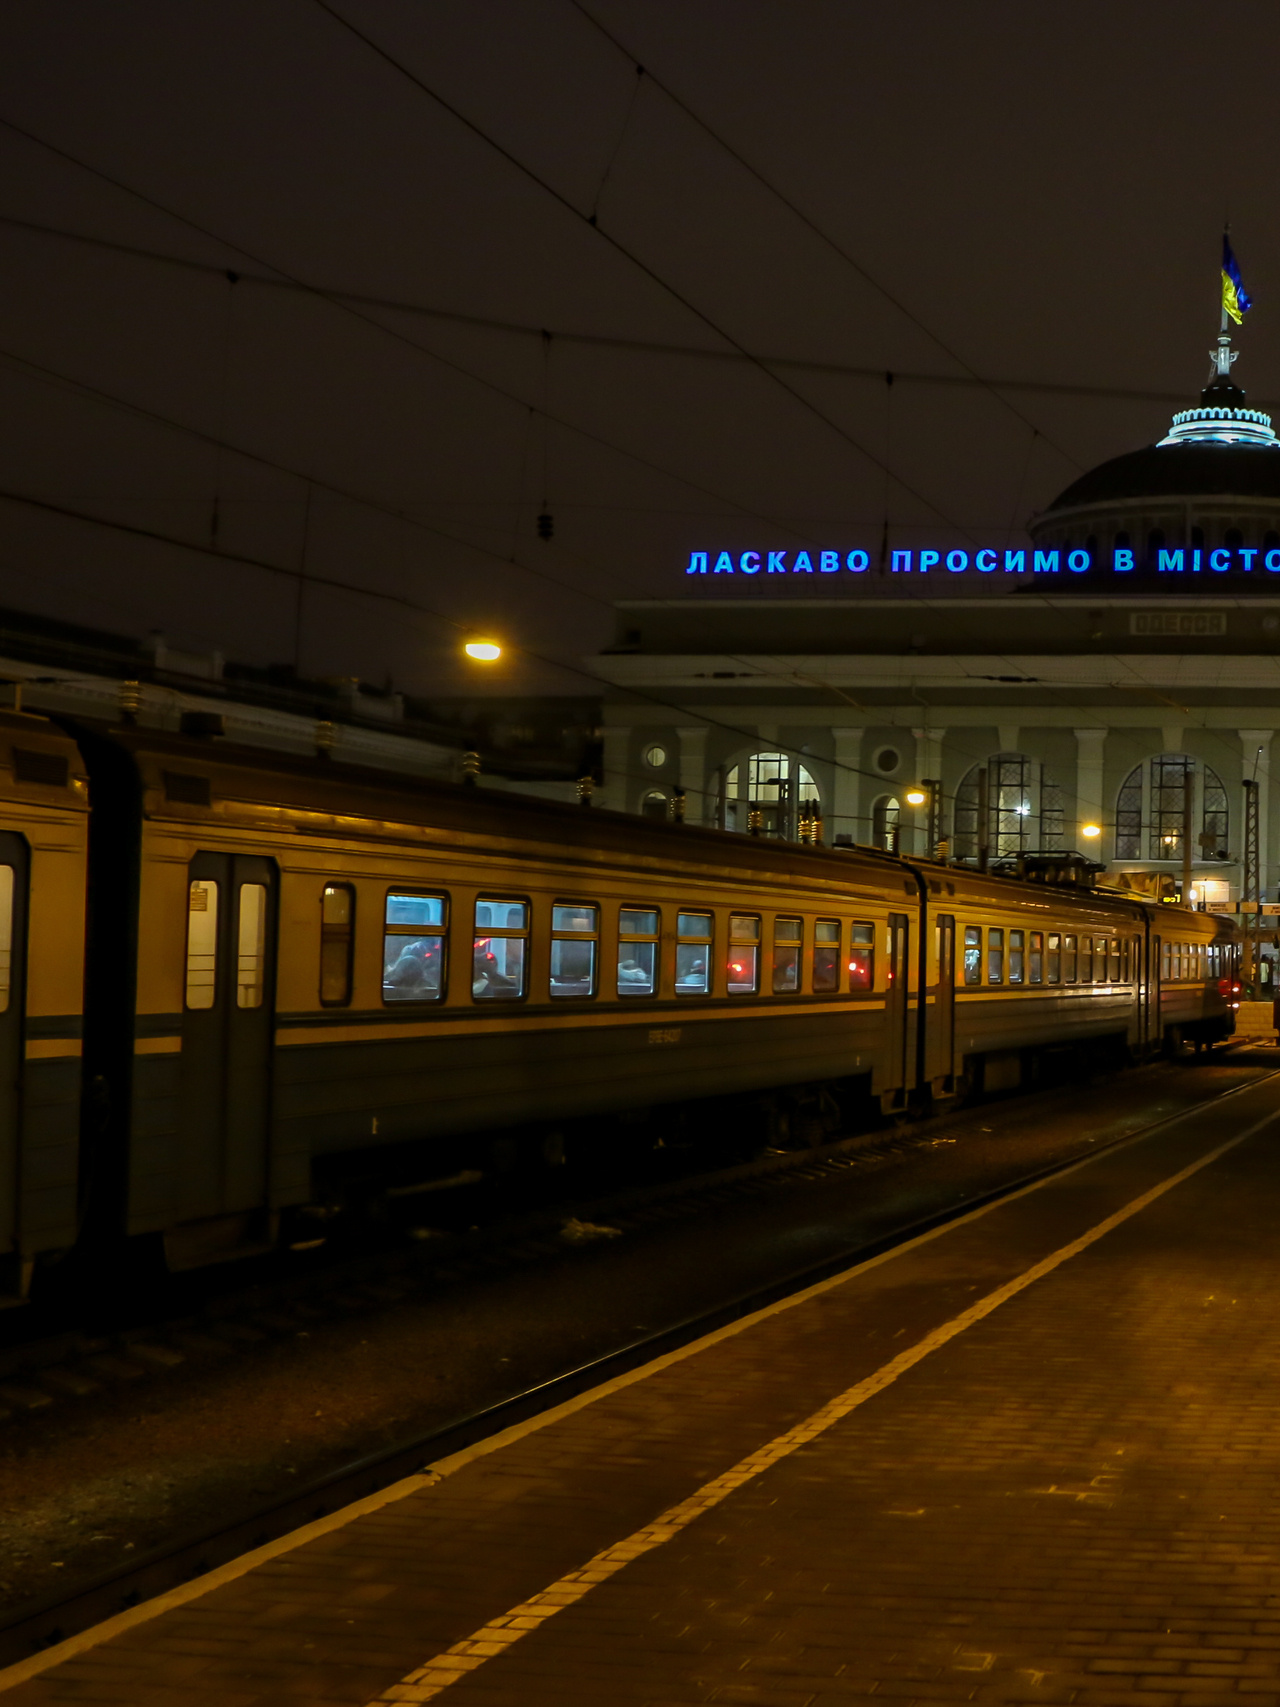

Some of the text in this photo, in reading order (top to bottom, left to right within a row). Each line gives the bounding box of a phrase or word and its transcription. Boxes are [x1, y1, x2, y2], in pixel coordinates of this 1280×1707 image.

[685, 549, 871, 575] ЛАСКАВО
[891, 548, 1091, 575] ПРОСИМО
[1113, 548, 1134, 573] В
